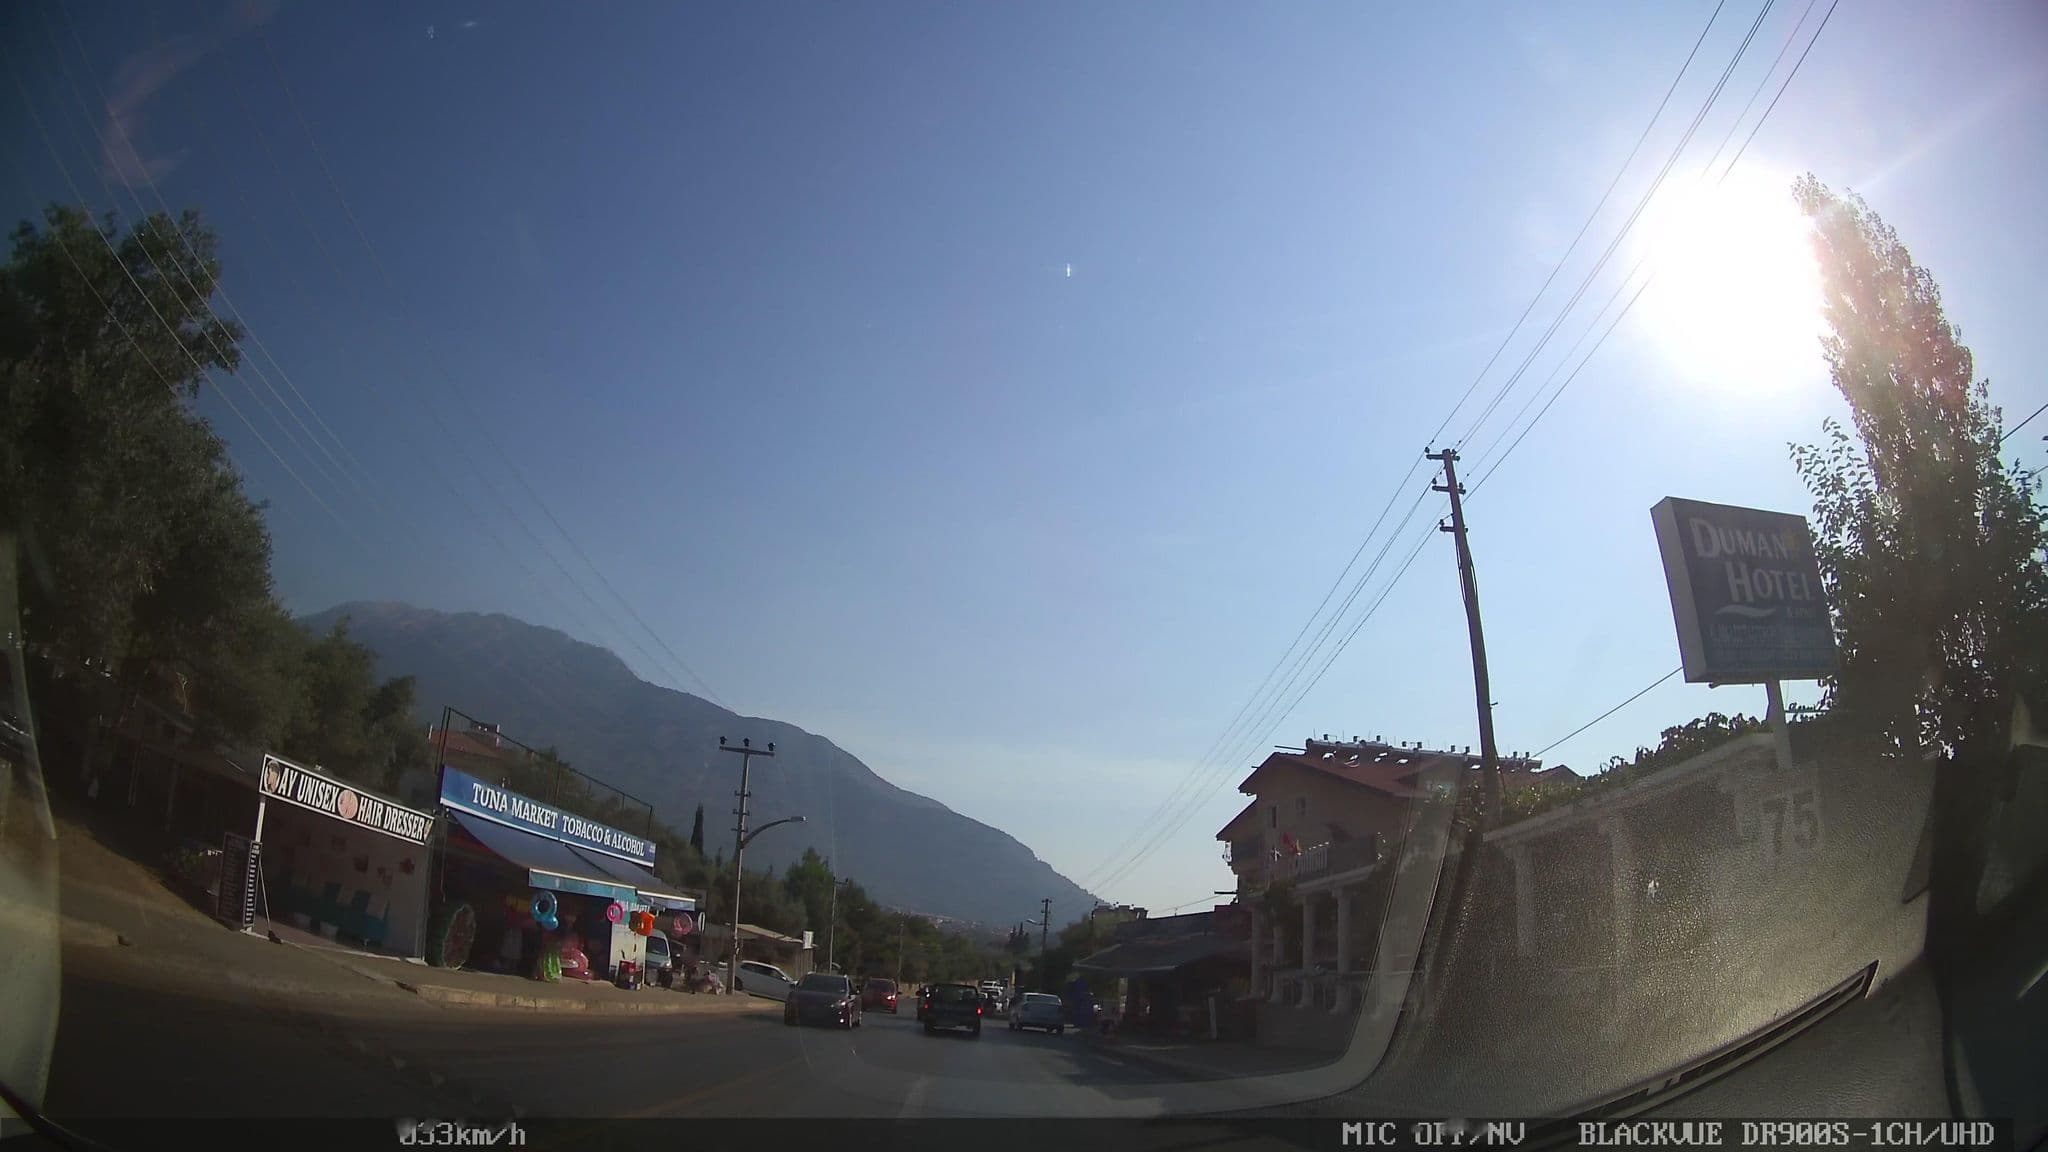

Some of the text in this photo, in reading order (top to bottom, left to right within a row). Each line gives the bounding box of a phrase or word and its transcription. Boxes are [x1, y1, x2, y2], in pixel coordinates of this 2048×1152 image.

[1690, 517, 1788, 560] DUMAN
[1726, 561, 1815, 603] HOTEL
[278, 767, 426, 840] AY UNISEX HAIR DRESSER
[473, 783, 645, 857] TUNA MARKET TOBACCO & ALCOHOL
[1763, 789, 1819, 856] 75
